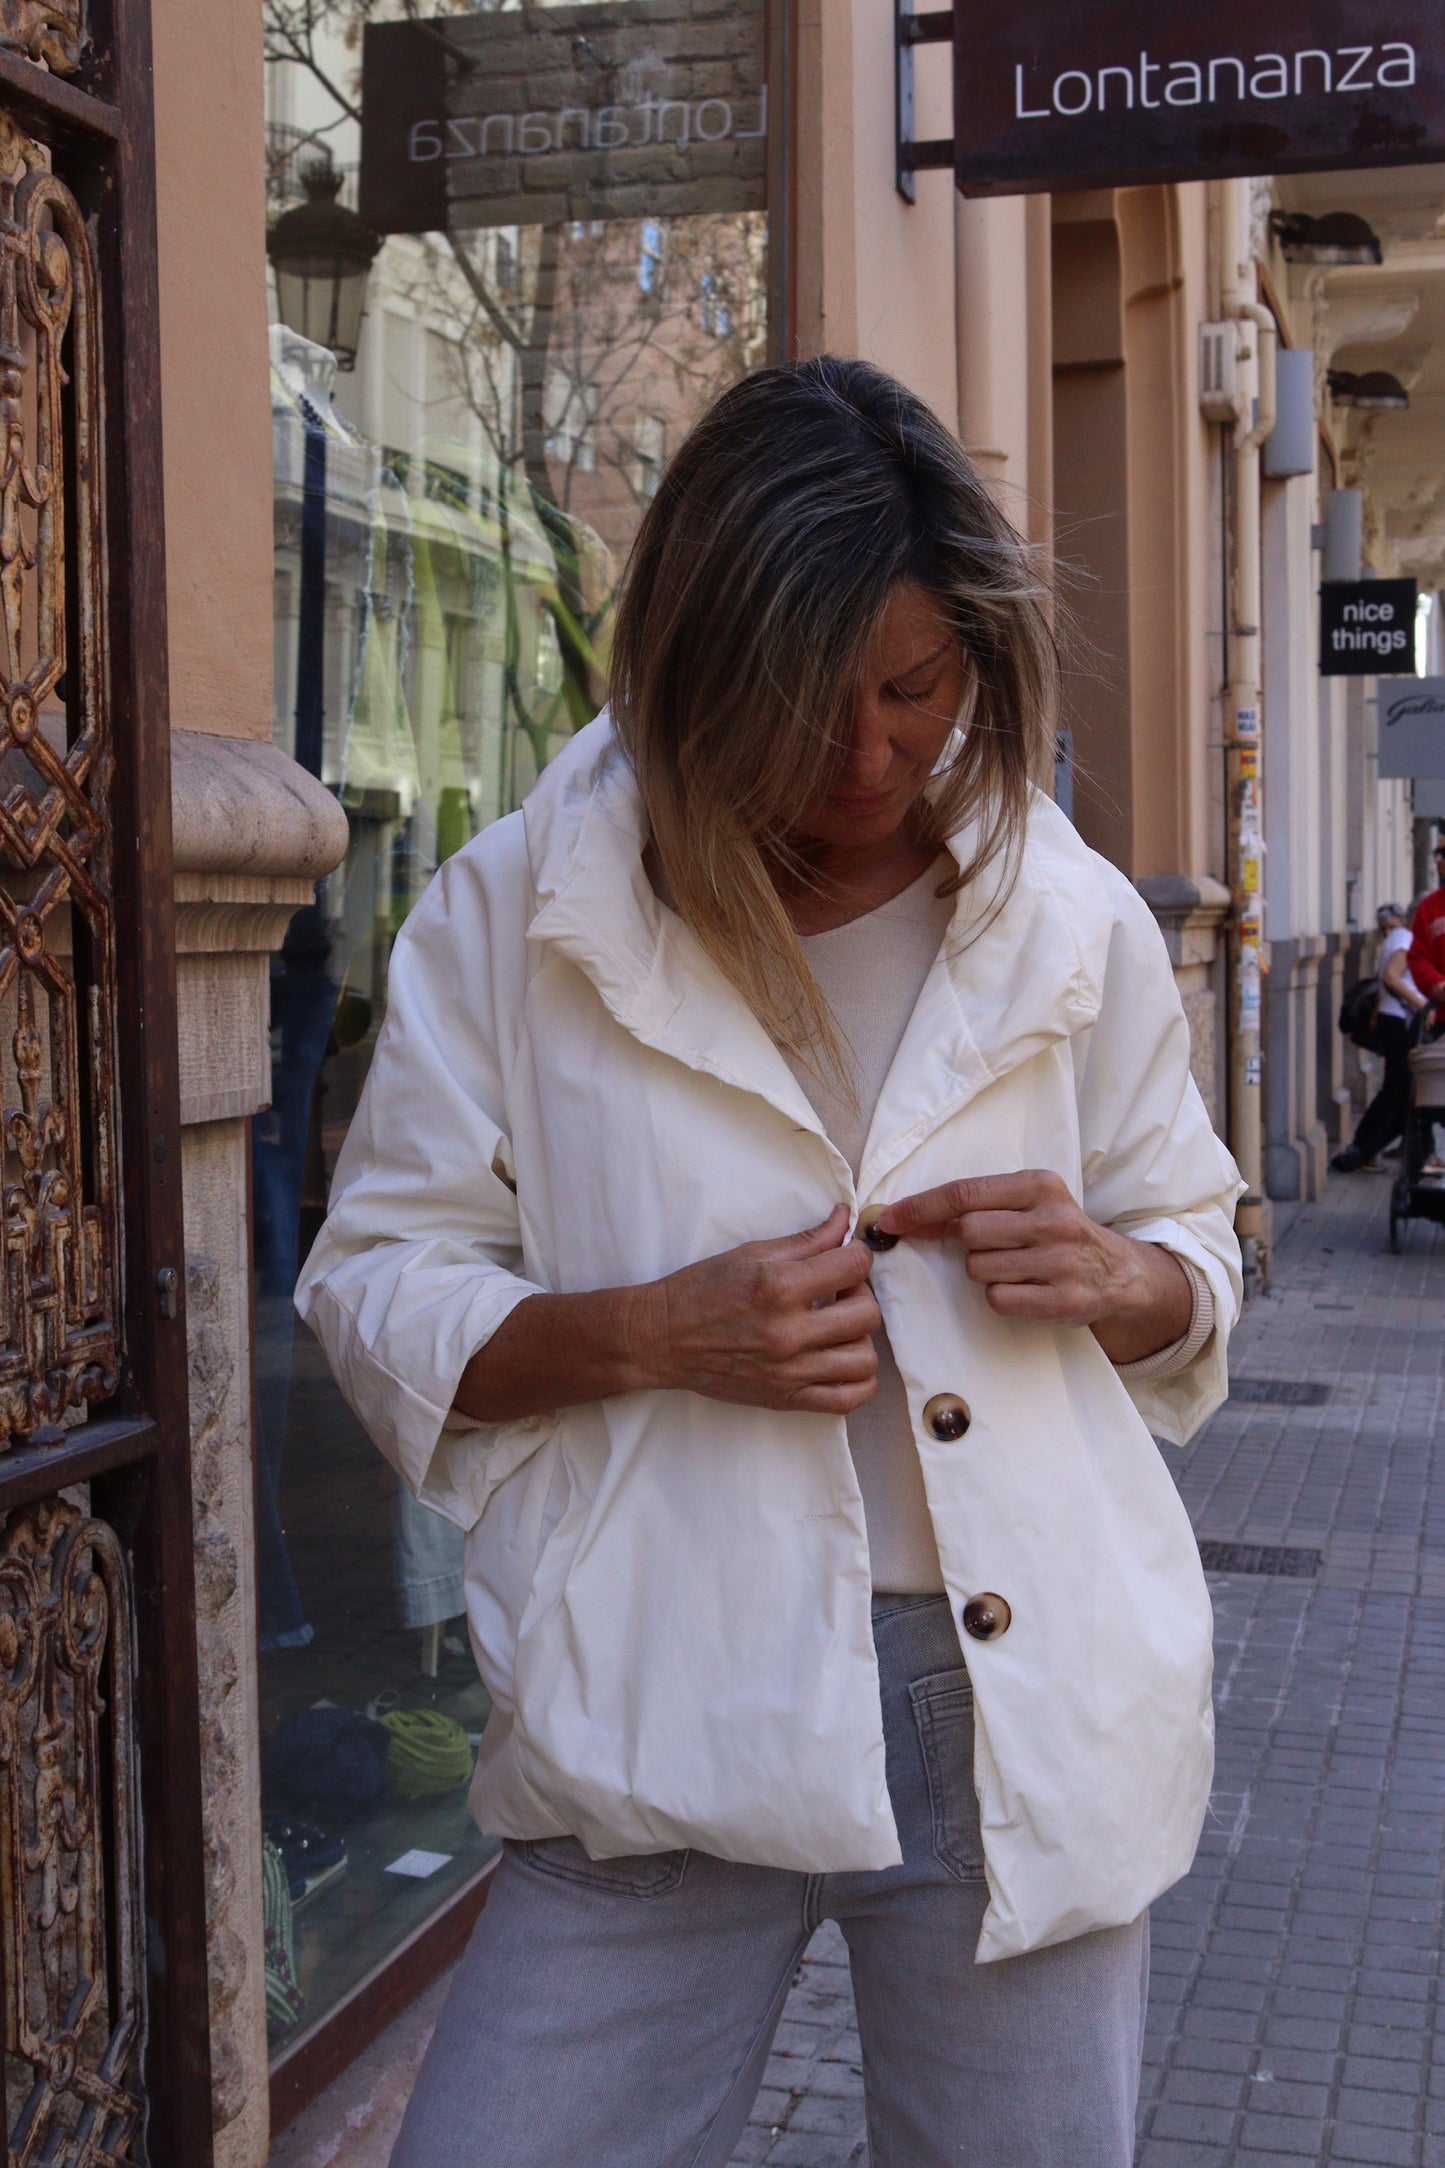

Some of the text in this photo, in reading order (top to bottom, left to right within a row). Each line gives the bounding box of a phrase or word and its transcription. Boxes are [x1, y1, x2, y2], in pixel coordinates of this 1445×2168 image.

[1015, 41, 1417, 119] Lontananza
[1343, 600, 1395, 622] nice
[1332, 627, 1407, 655] things
